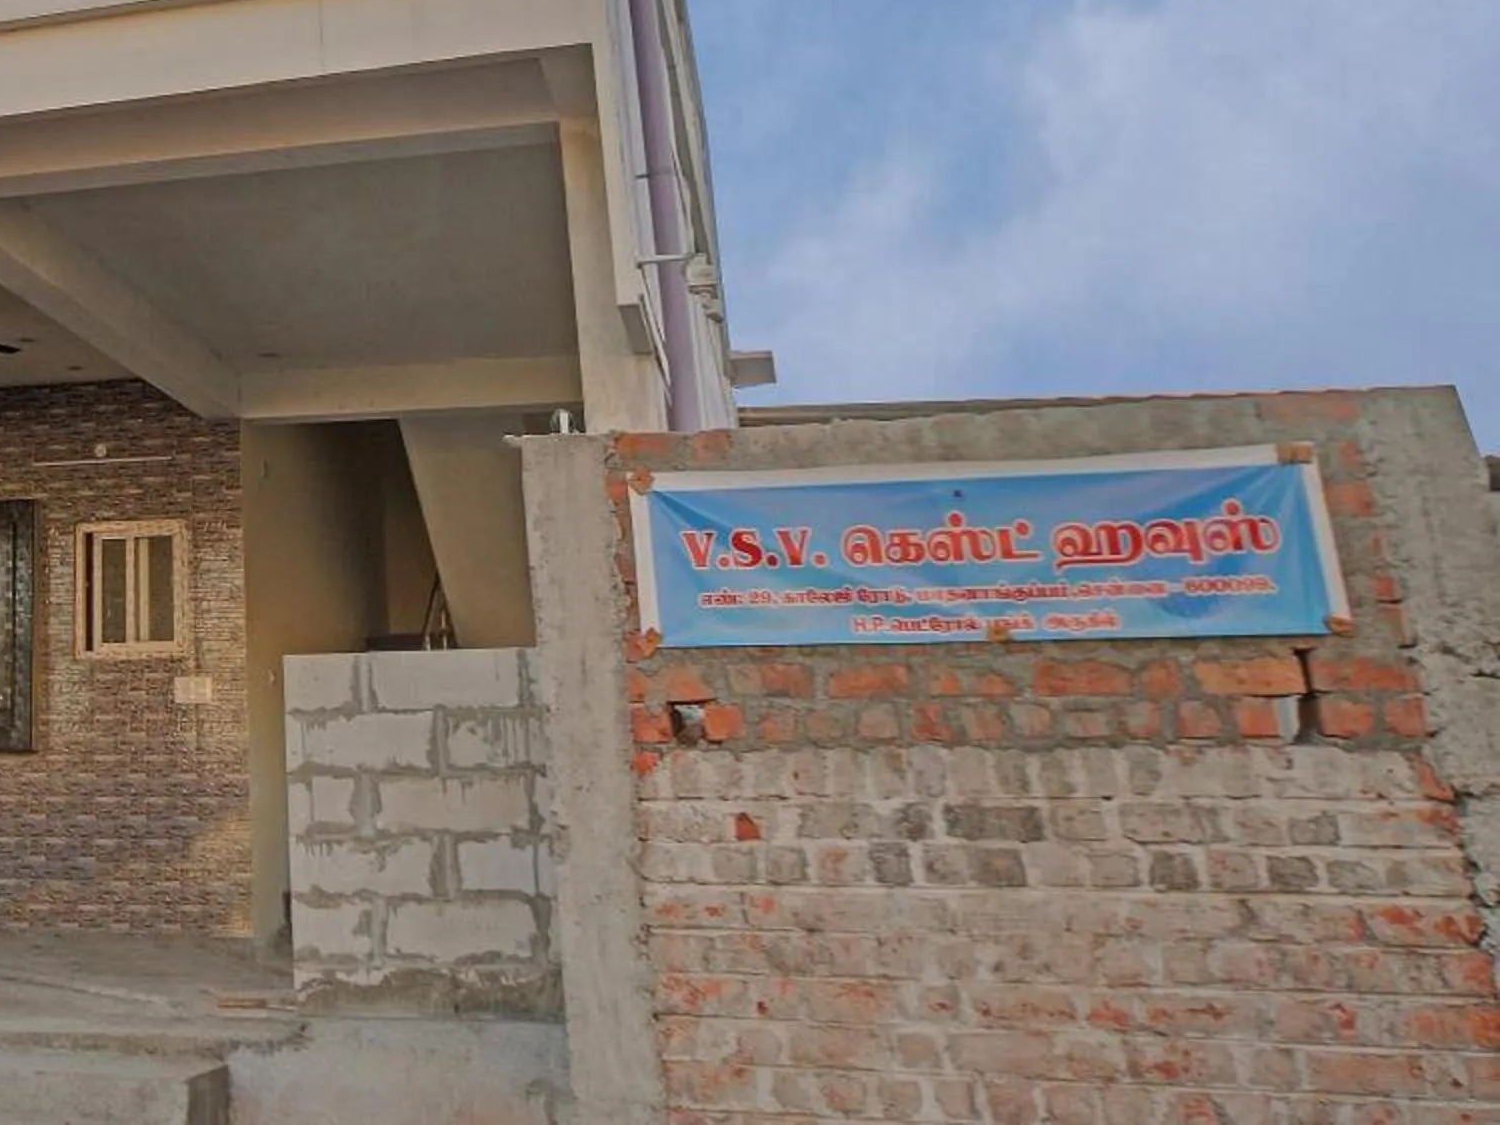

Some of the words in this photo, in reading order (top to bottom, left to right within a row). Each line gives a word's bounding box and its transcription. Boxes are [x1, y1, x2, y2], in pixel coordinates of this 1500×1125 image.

[681, 526, 829, 569] V.S.V.
[842, 510, 1041, 565] கெஸ்ட்
[1052, 499, 1281, 573] ஹவுஸ்
